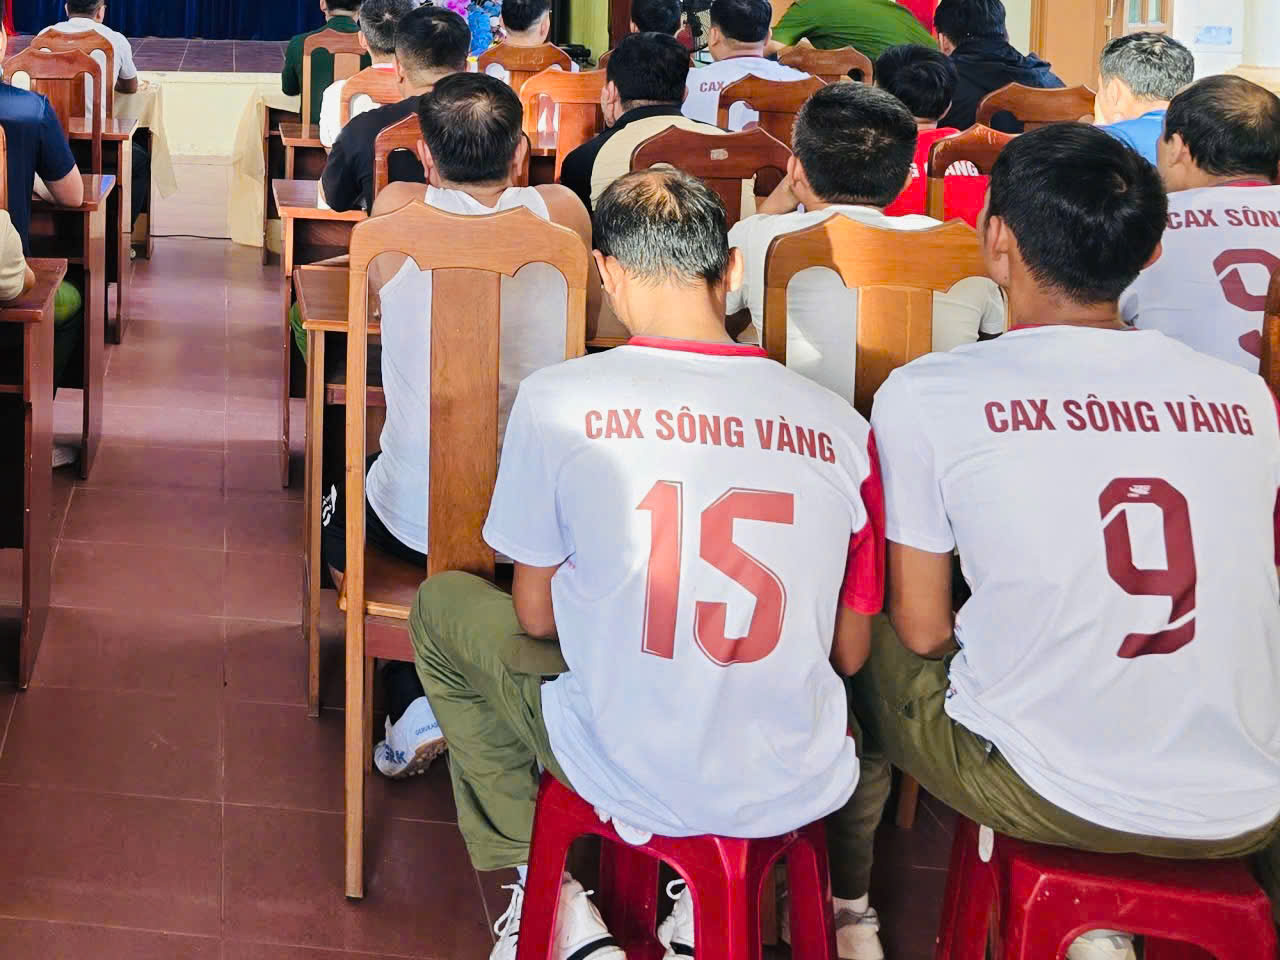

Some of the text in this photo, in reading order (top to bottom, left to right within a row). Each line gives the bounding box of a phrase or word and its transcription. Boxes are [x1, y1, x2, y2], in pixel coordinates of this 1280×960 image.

[1167, 205, 1280, 230] CAX SÔN
[584, 406, 836, 465] CAX SÔNG VÀNG
[984, 393, 1254, 436] CAX SÔNG VÀNG
[635, 480, 794, 668] 15
[1098, 477, 1197, 659] 9
